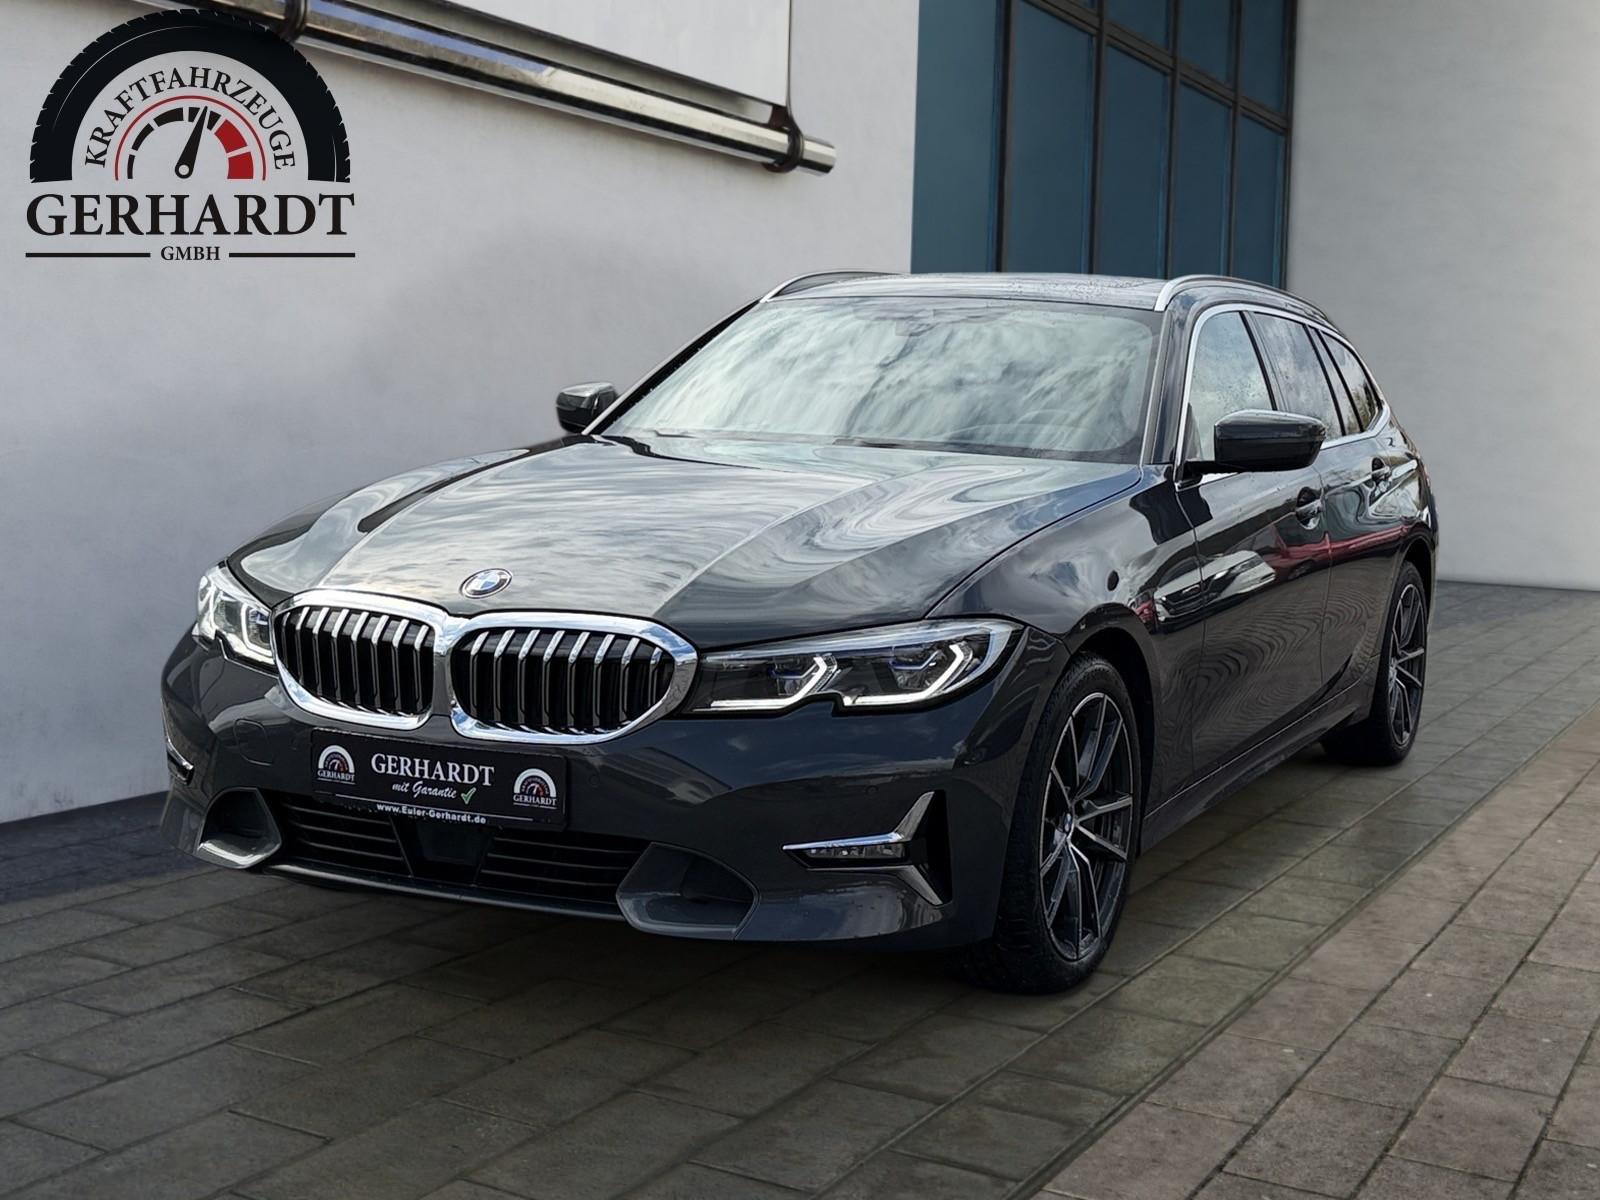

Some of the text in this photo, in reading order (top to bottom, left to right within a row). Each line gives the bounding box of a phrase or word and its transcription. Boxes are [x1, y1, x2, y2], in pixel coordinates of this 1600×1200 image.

[317, 770, 355, 782] GERHARDT
[371, 753, 495, 786] GERHARDT
[391, 781, 457, 798] mit Garantie
[513, 794, 557, 807] GERHARDT
[376, 803, 487, 824] www.Euler-Gerhardt.de
